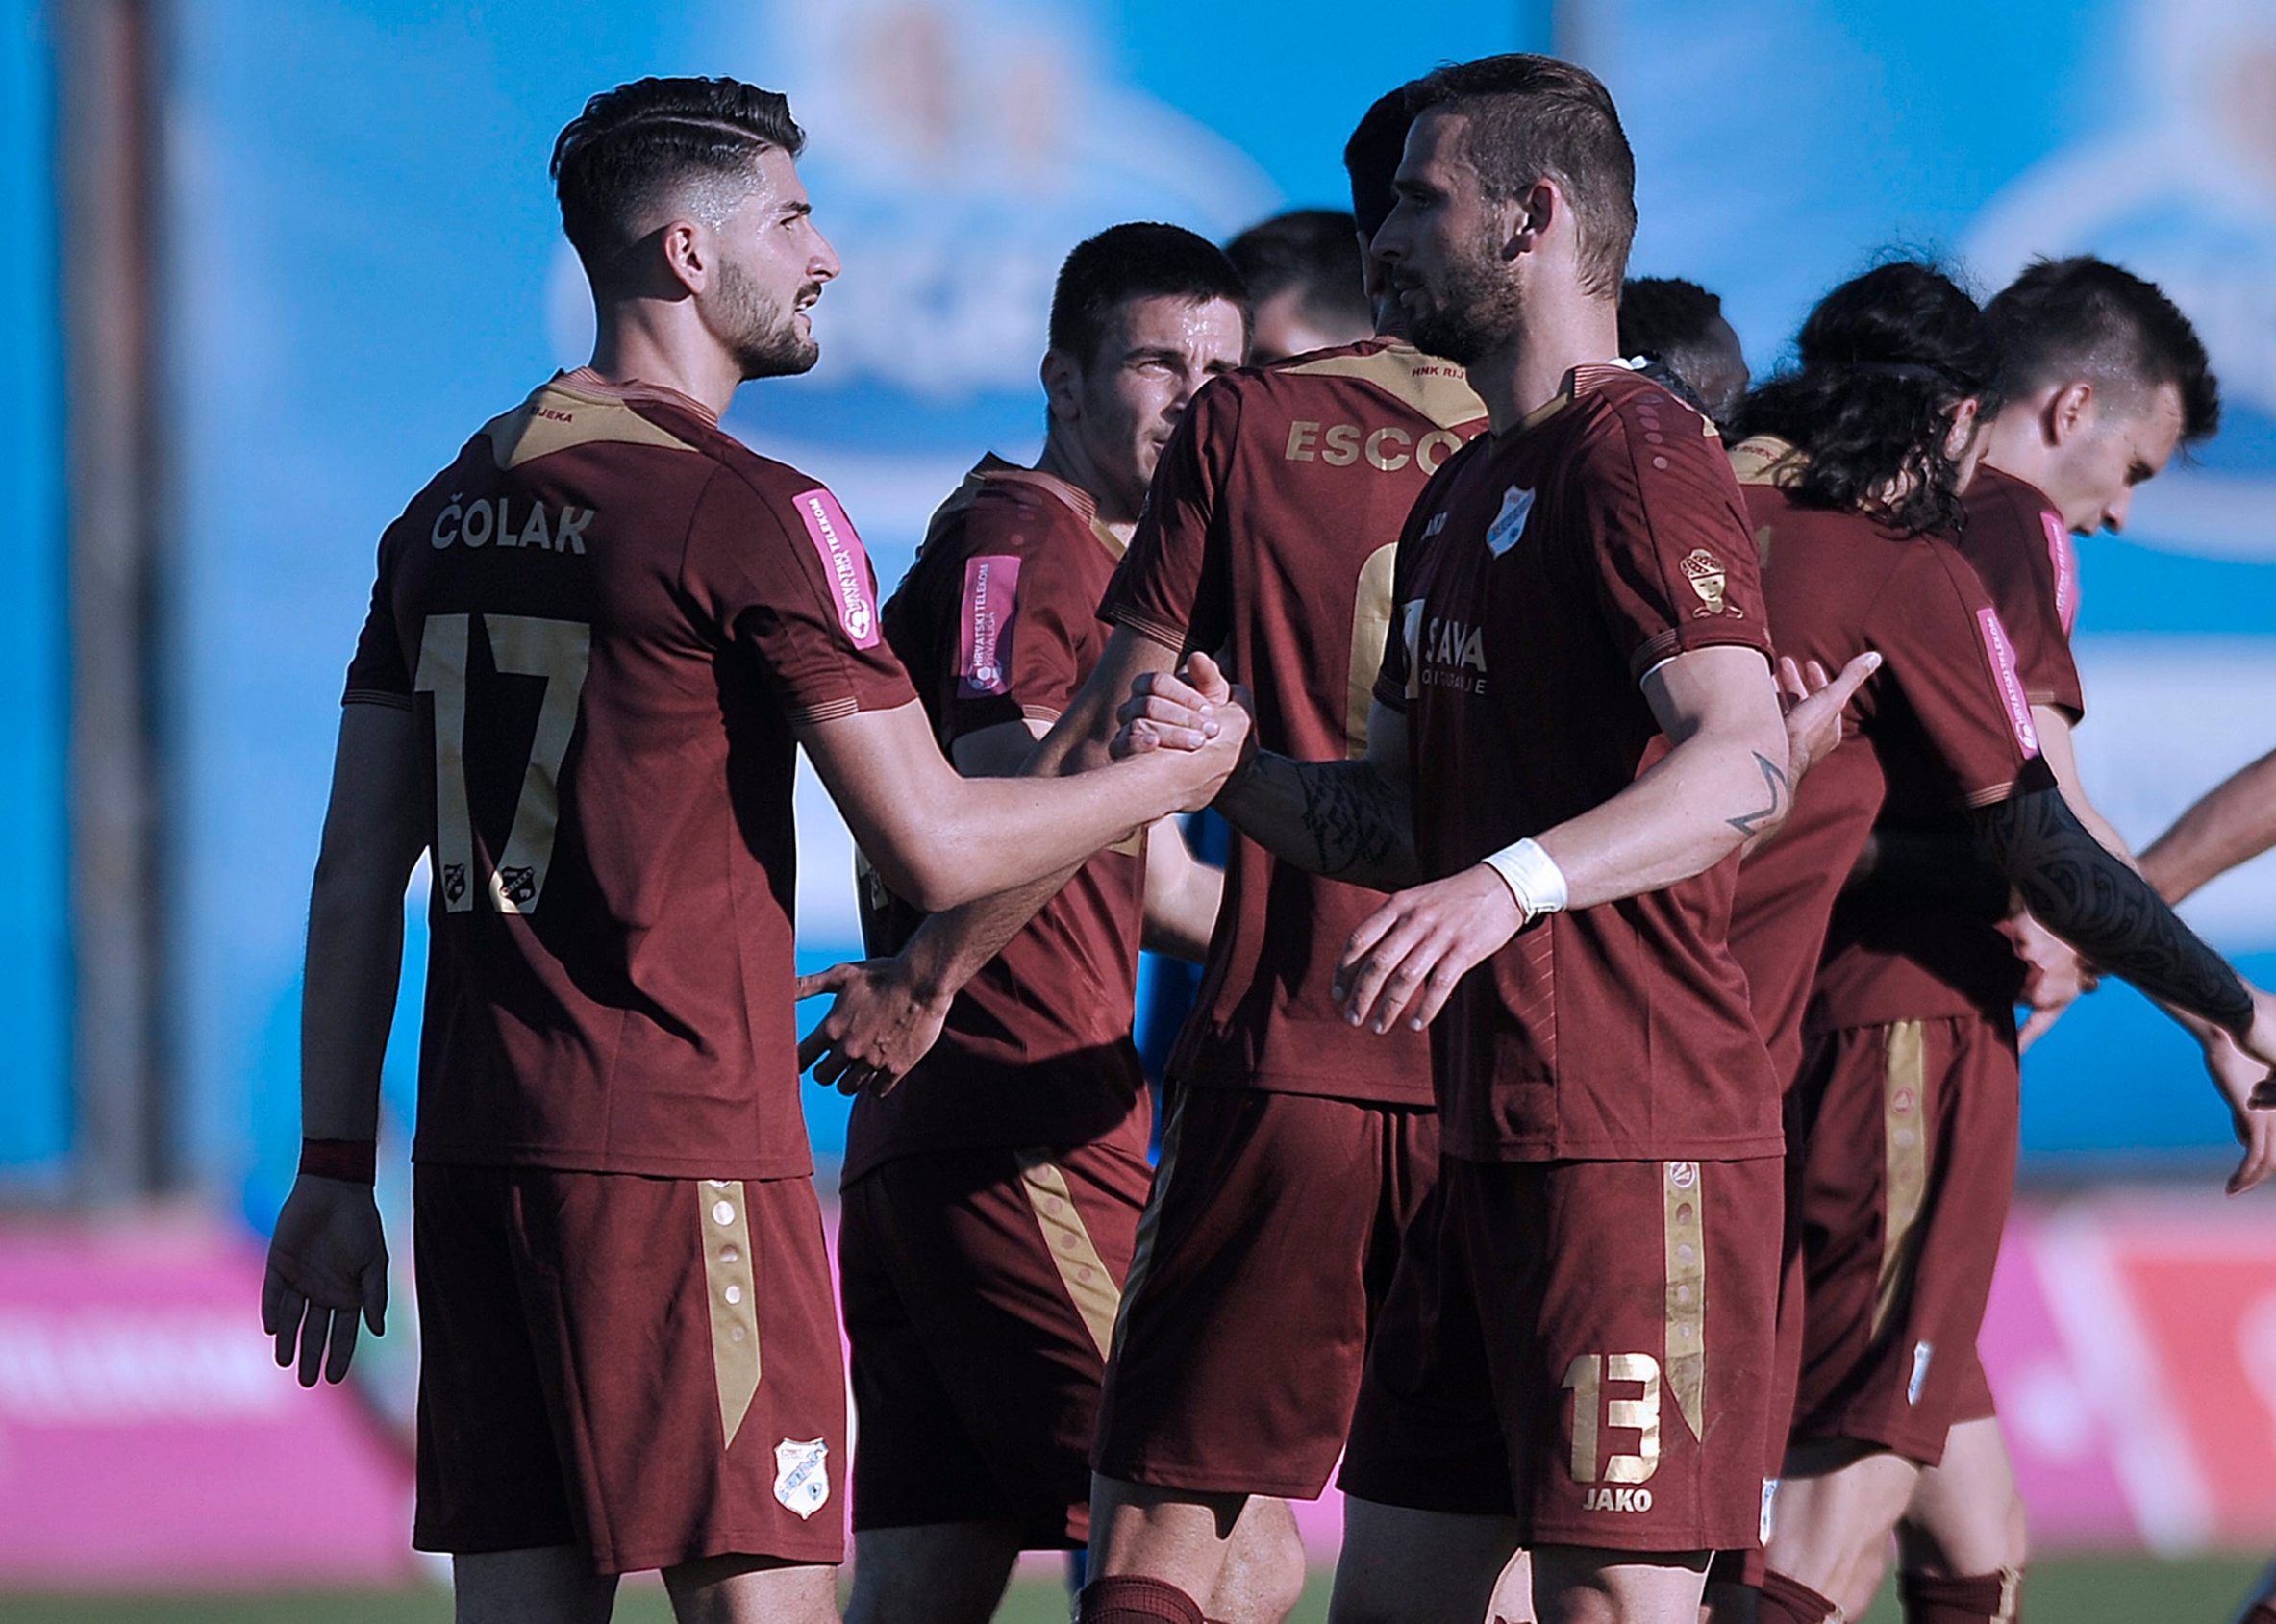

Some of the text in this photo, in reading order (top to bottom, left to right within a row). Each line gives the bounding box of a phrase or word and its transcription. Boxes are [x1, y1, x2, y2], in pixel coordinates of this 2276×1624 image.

[1412, 365, 1464, 380] HNK RIJ
[1284, 420, 1463, 478] ESCO
[431, 491, 596, 555] ČOLAK
[808, 497, 841, 553] TELEKOM
[973, 563, 989, 667] HRVATSKI TELEKOM
[986, 612, 996, 637] LIGA
[1425, 617, 1488, 672] SAVA
[414, 612, 591, 914] 17
[1560, 1352, 1662, 1485] 13
[1582, 1488, 1654, 1512] JAKO
